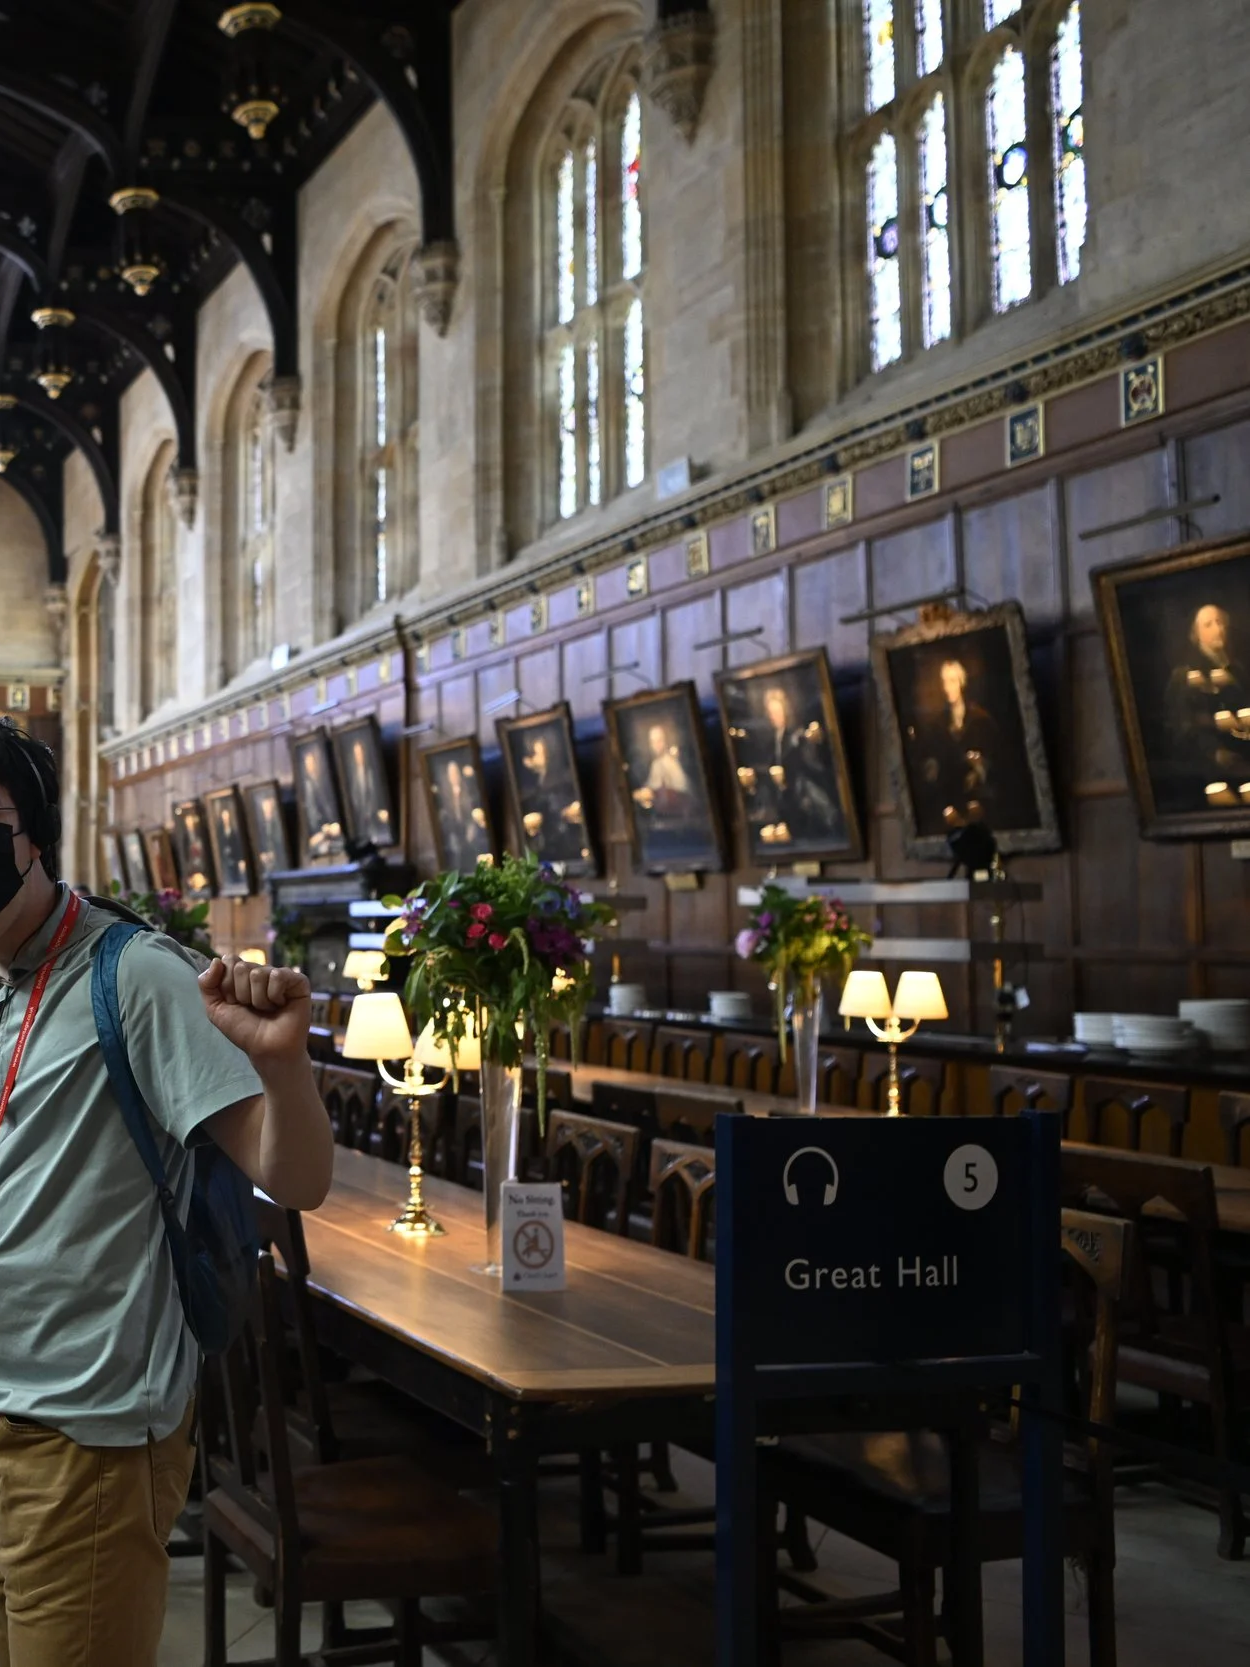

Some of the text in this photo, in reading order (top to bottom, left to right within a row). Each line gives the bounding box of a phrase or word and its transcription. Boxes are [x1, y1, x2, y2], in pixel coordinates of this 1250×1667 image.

[963, 1163, 978, 1193] 5
[784, 1255, 959, 1290] Great Hall
